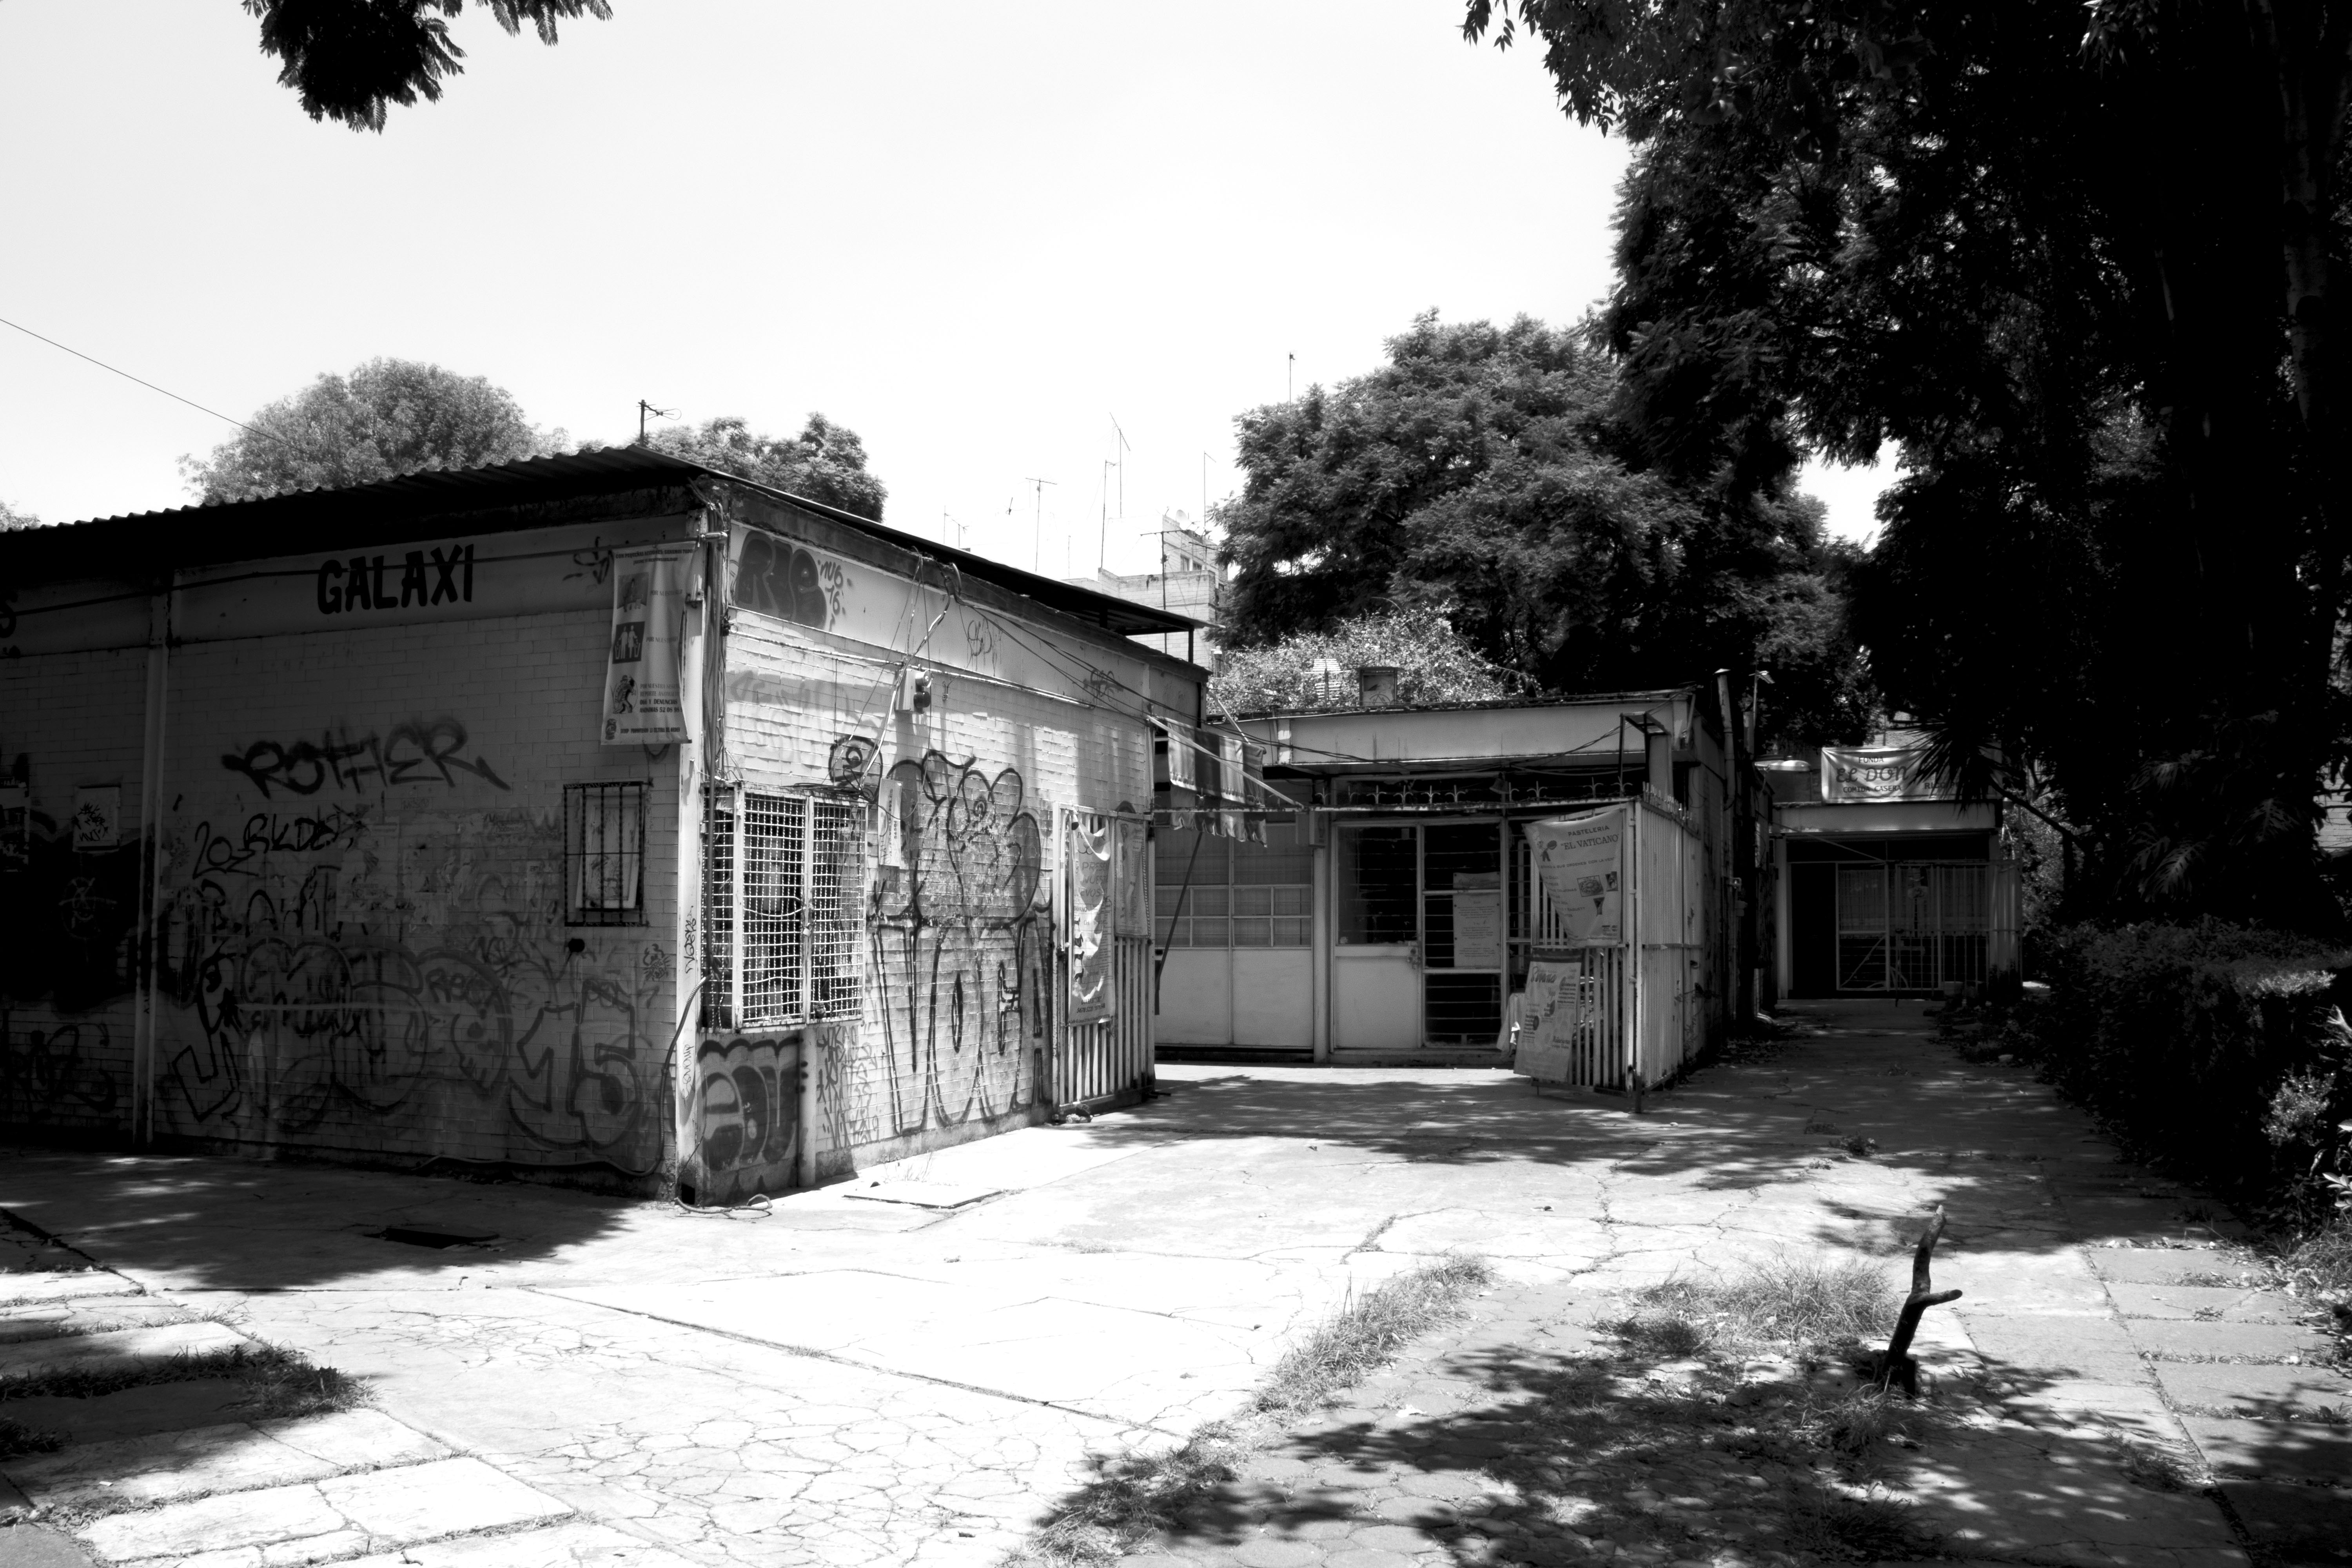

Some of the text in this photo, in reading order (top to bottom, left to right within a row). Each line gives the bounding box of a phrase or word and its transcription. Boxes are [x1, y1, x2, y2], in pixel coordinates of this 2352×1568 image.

[318, 544, 474, 614] GALAXI
[1836, 766, 1909, 782] EL DON
[1568, 826, 1610, 837] PASTELERIA
